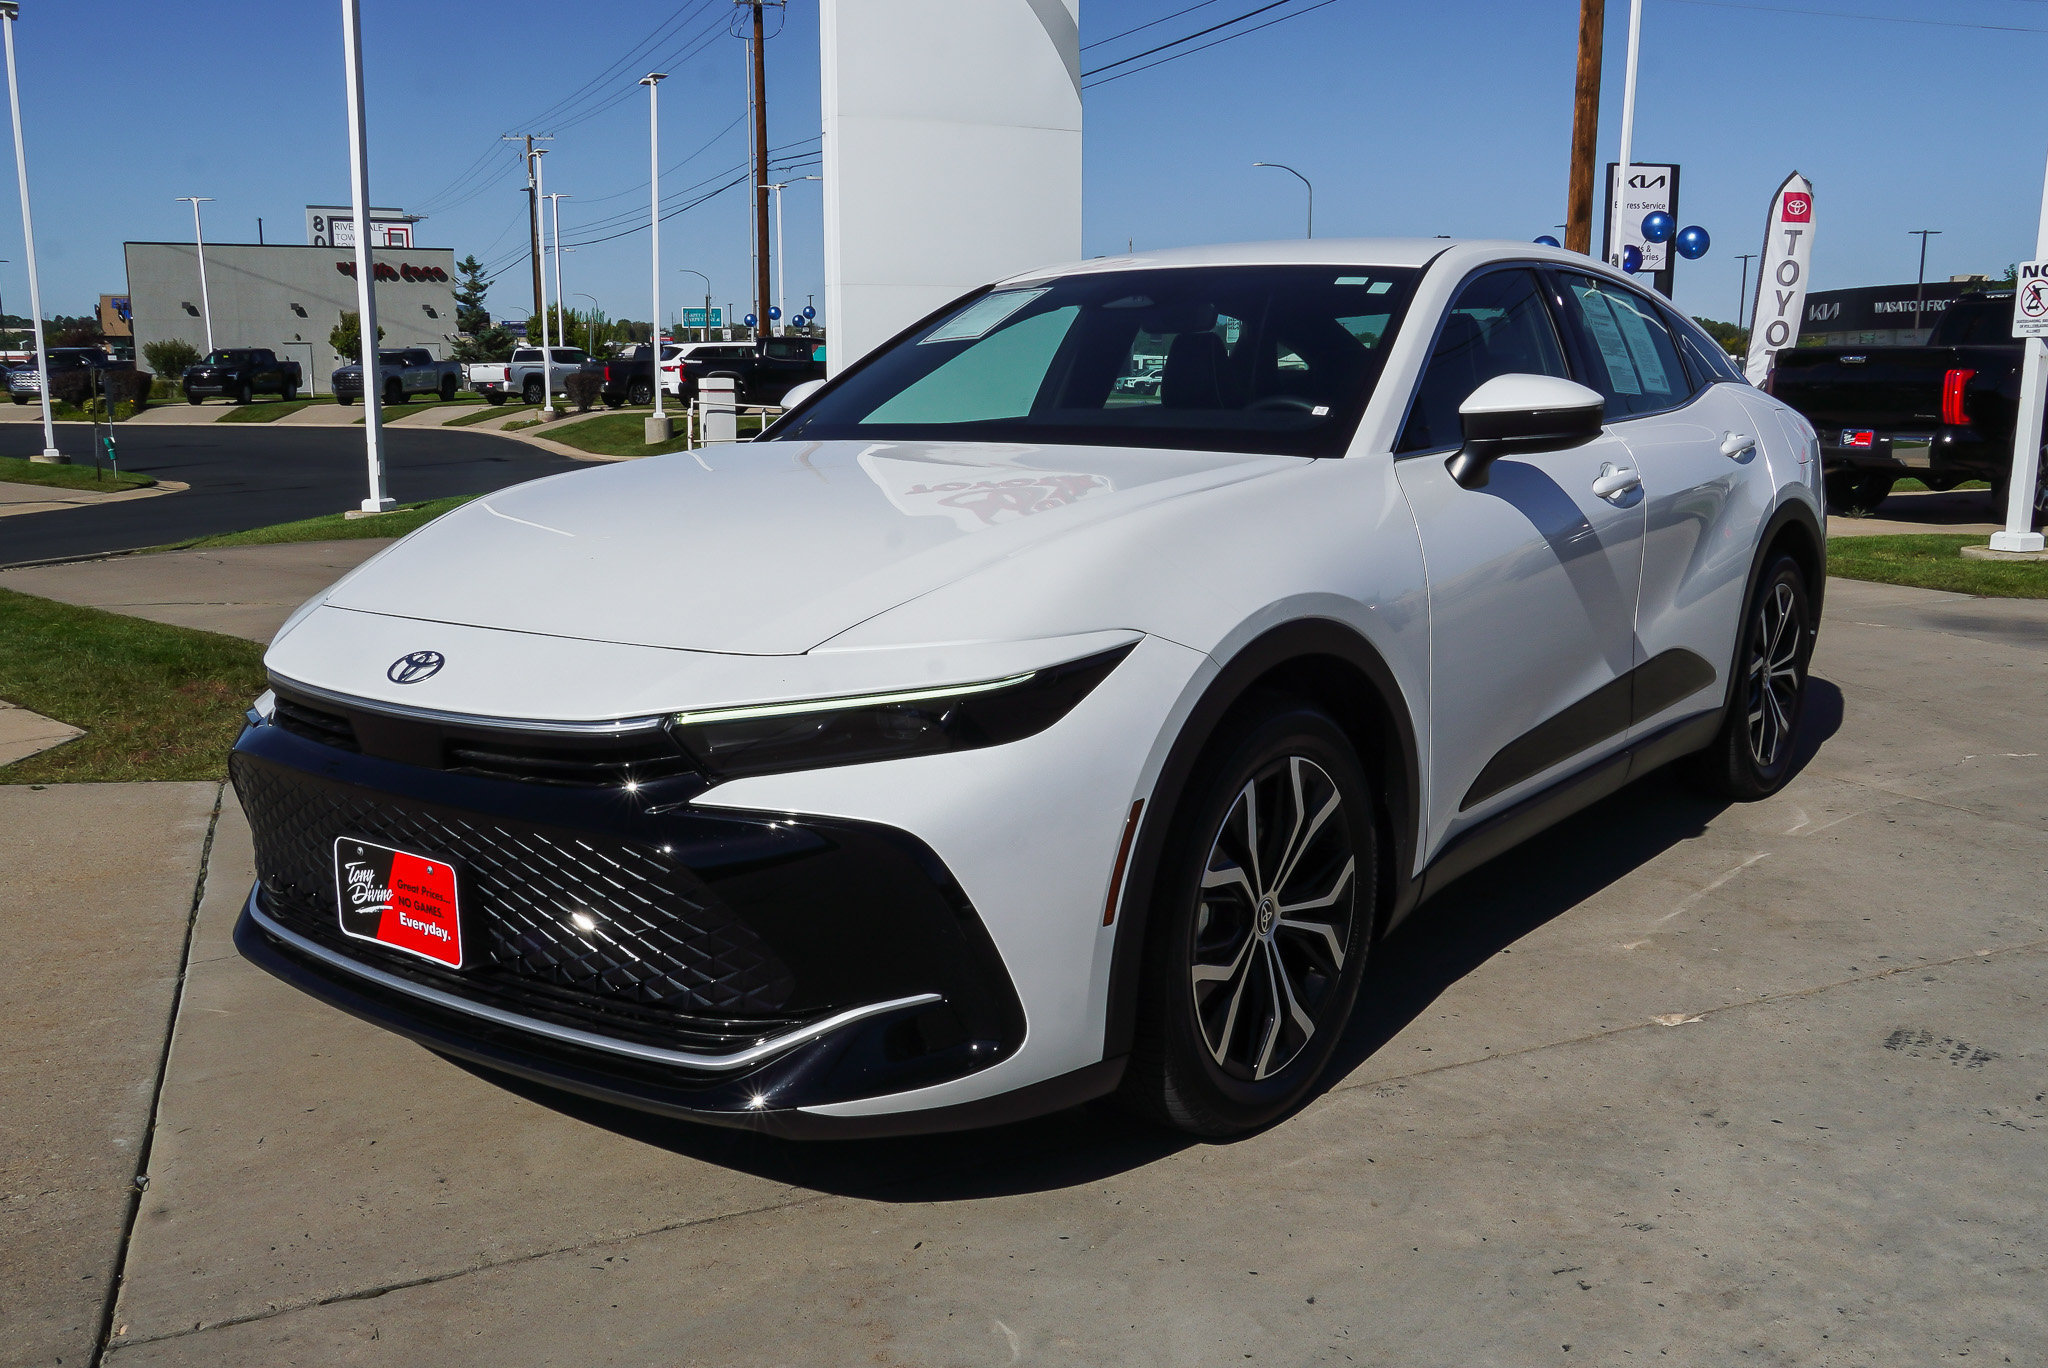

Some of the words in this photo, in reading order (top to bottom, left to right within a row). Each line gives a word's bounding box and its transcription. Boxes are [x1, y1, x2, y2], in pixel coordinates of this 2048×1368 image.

[1614, 201, 1641, 210] Eress
[1641, 201, 1666, 210] Service
[334, 222, 384, 232] RIVELE
[1758, 229, 1803, 388] TOYOT
[1808, 302, 1840, 321] KIA
[1874, 300, 1925, 313] WASATCH
[345, 861, 376, 889] Tony
[397, 879, 420, 895] Great
[398, 895, 412, 909] NO
[399, 911, 452, 942] Everyday.
